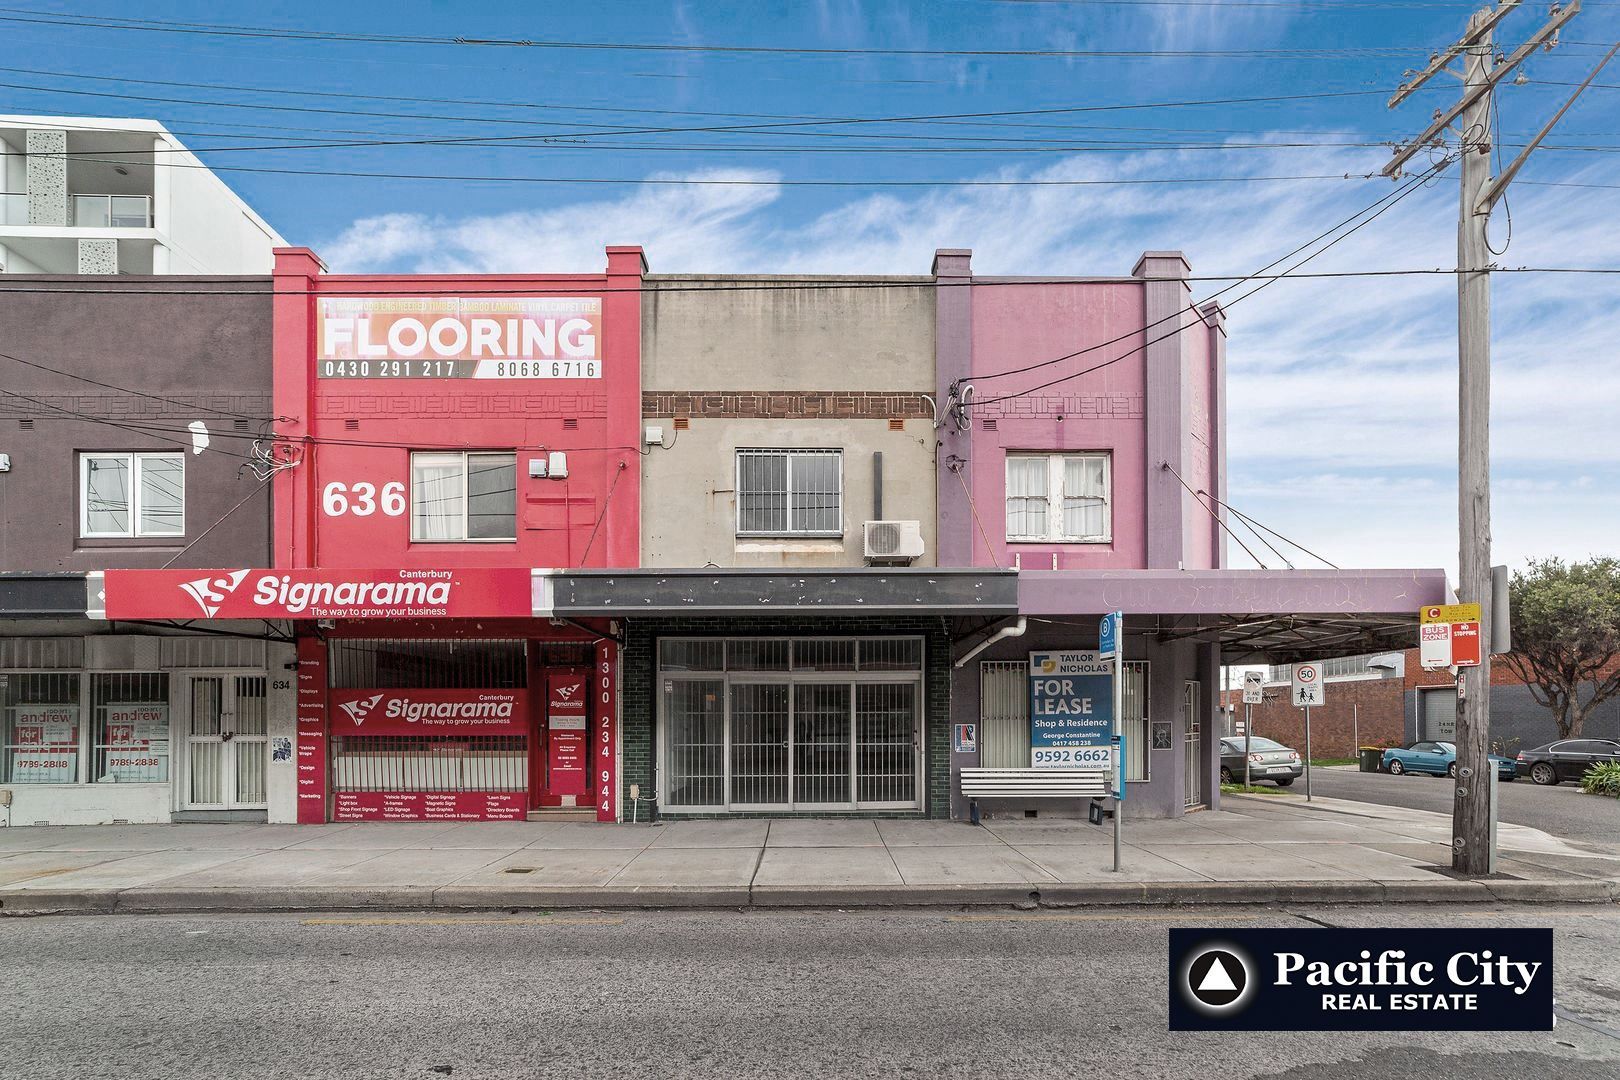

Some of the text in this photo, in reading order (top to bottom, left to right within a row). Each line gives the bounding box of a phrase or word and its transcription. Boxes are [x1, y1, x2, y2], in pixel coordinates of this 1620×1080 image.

[324, 317, 596, 357] FLOORING
[325, 361, 455, 377] 0430 291 217
[497, 362, 595, 377] 8068 6716
[322, 481, 406, 517] 636
[400, 570, 452, 580] Canterbury
[253, 575, 451, 613] Signarama
[311, 607, 447, 617] The way to grow your business
[1429, 608, 1438, 618] C
[1425, 626, 1445, 634] BUS
[1423, 633, 1448, 641] ZONE
[1060, 654, 1094, 662] TAYLOR
[1060, 664, 1108, 673] NICHOLAS
[1301, 670, 1313, 679] 50
[272, 681, 290, 690] 634
[1034, 680, 1075, 696] FOR
[479, 694, 514, 702] Canterbury
[550, 700, 584, 708] Signarama
[1034, 698, 1093, 715] LEASE
[112, 709, 162, 721] andrew
[385, 699, 513, 723] Signarama
[21, 711, 72, 723] andrew
[1034, 718, 1108, 728] Shop & Residence
[21, 729, 37, 738] for
[112, 727, 129, 737] for
[1065, 731, 1101, 739] Constantine
[1035, 749, 1109, 763] 9592 6662
